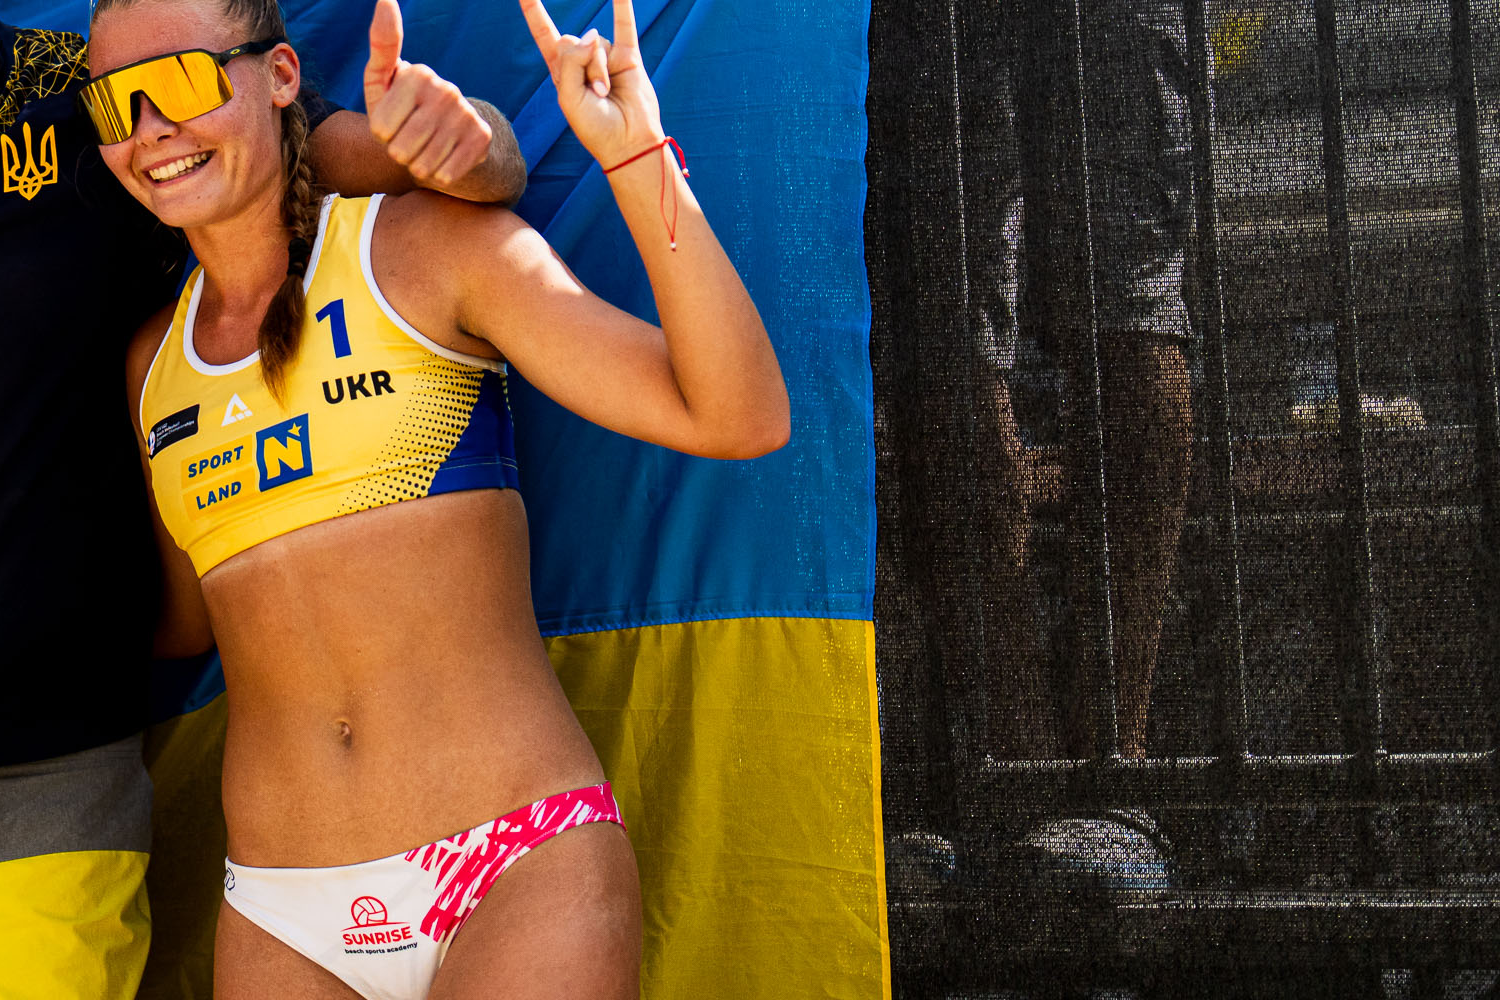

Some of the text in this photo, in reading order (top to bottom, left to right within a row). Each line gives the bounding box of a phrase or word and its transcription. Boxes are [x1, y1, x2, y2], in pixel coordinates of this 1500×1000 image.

[315, 298, 353, 359] 1
[321, 369, 396, 405] UKR
[187, 445, 244, 479] SPORT
[195, 480, 242, 510] LAND
[342, 926, 413, 945] SUNRISE
[386, 942, 418, 953] academy
